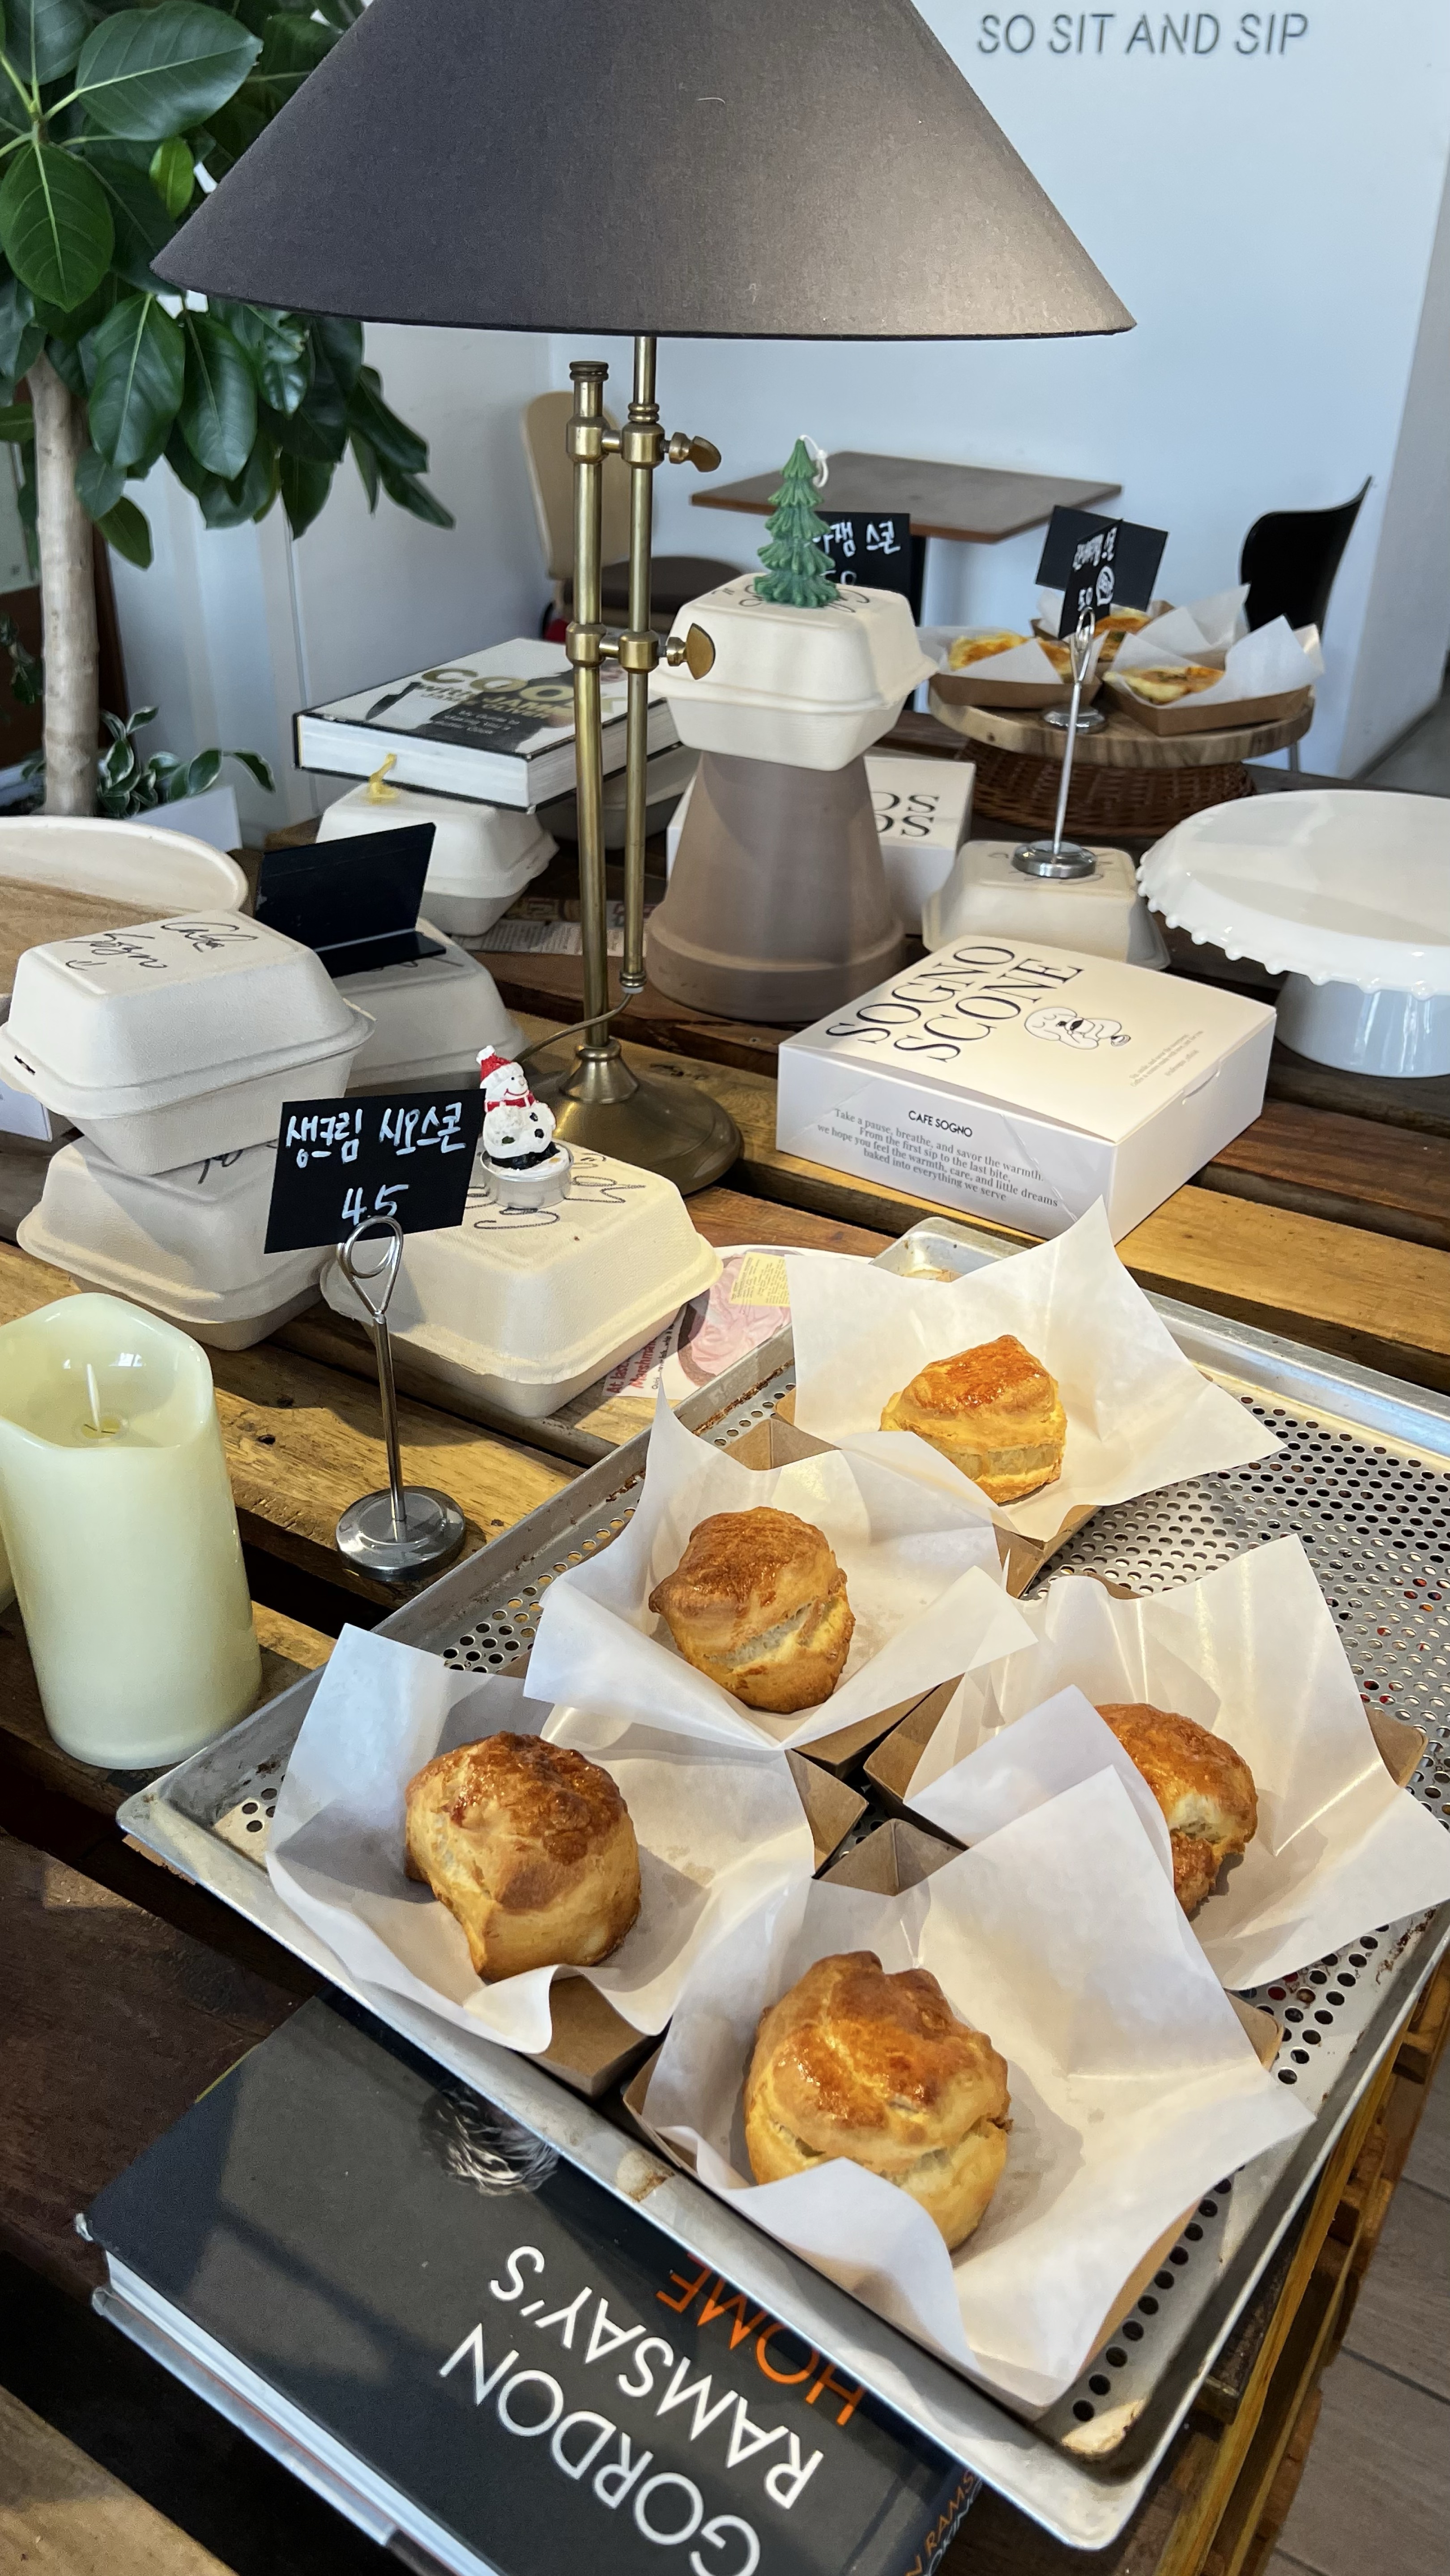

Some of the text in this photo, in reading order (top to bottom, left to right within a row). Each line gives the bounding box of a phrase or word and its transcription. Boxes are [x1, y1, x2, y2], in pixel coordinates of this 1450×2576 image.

[978, 13, 1308, 54] SO SIT AND SIP
[866, 520, 901, 555] 스콘
[826, 946, 1015, 1044] SOGNO
[893, 958, 1085, 1063] SCONE
[285, 1108, 363, 1168] 생크림
[378, 1102, 467, 1156] 시오스콘
[834, 1108, 855, 1122] Take
[865, 1120, 893, 1135] pause,
[896, 1127, 933, 1148] breathe,
[936, 1143, 954, 1154] and
[957, 1149, 982, 1162] savor
[985, 1156, 1000, 1168] the
[860, 1127, 1011, 1183] From the first sip to the last bite,
[908, 1110, 972, 1137] CAFE SOGNO
[818, 1124, 830, 1134] we
[832, 1127, 853, 1142] hope
[855, 1137, 871, 1148] you
[874, 1141, 889, 1154] feel
[892, 1148, 906, 1159] the
[975, 1175, 993, 1187] and
[996, 1179, 1018, 1195] little
[1021, 1188, 1058, 1207] dreams
[864, 1148, 1006, 1201] baked into everything we serve
[606, 1381, 624, 1393] At
[656, 2252, 866, 2427] HOME
[490, 2246, 823, 2509] RAMSAY'S
[440, 2323, 760, 2576] GORDON
[925, 2470, 976, 2558] RAMS
